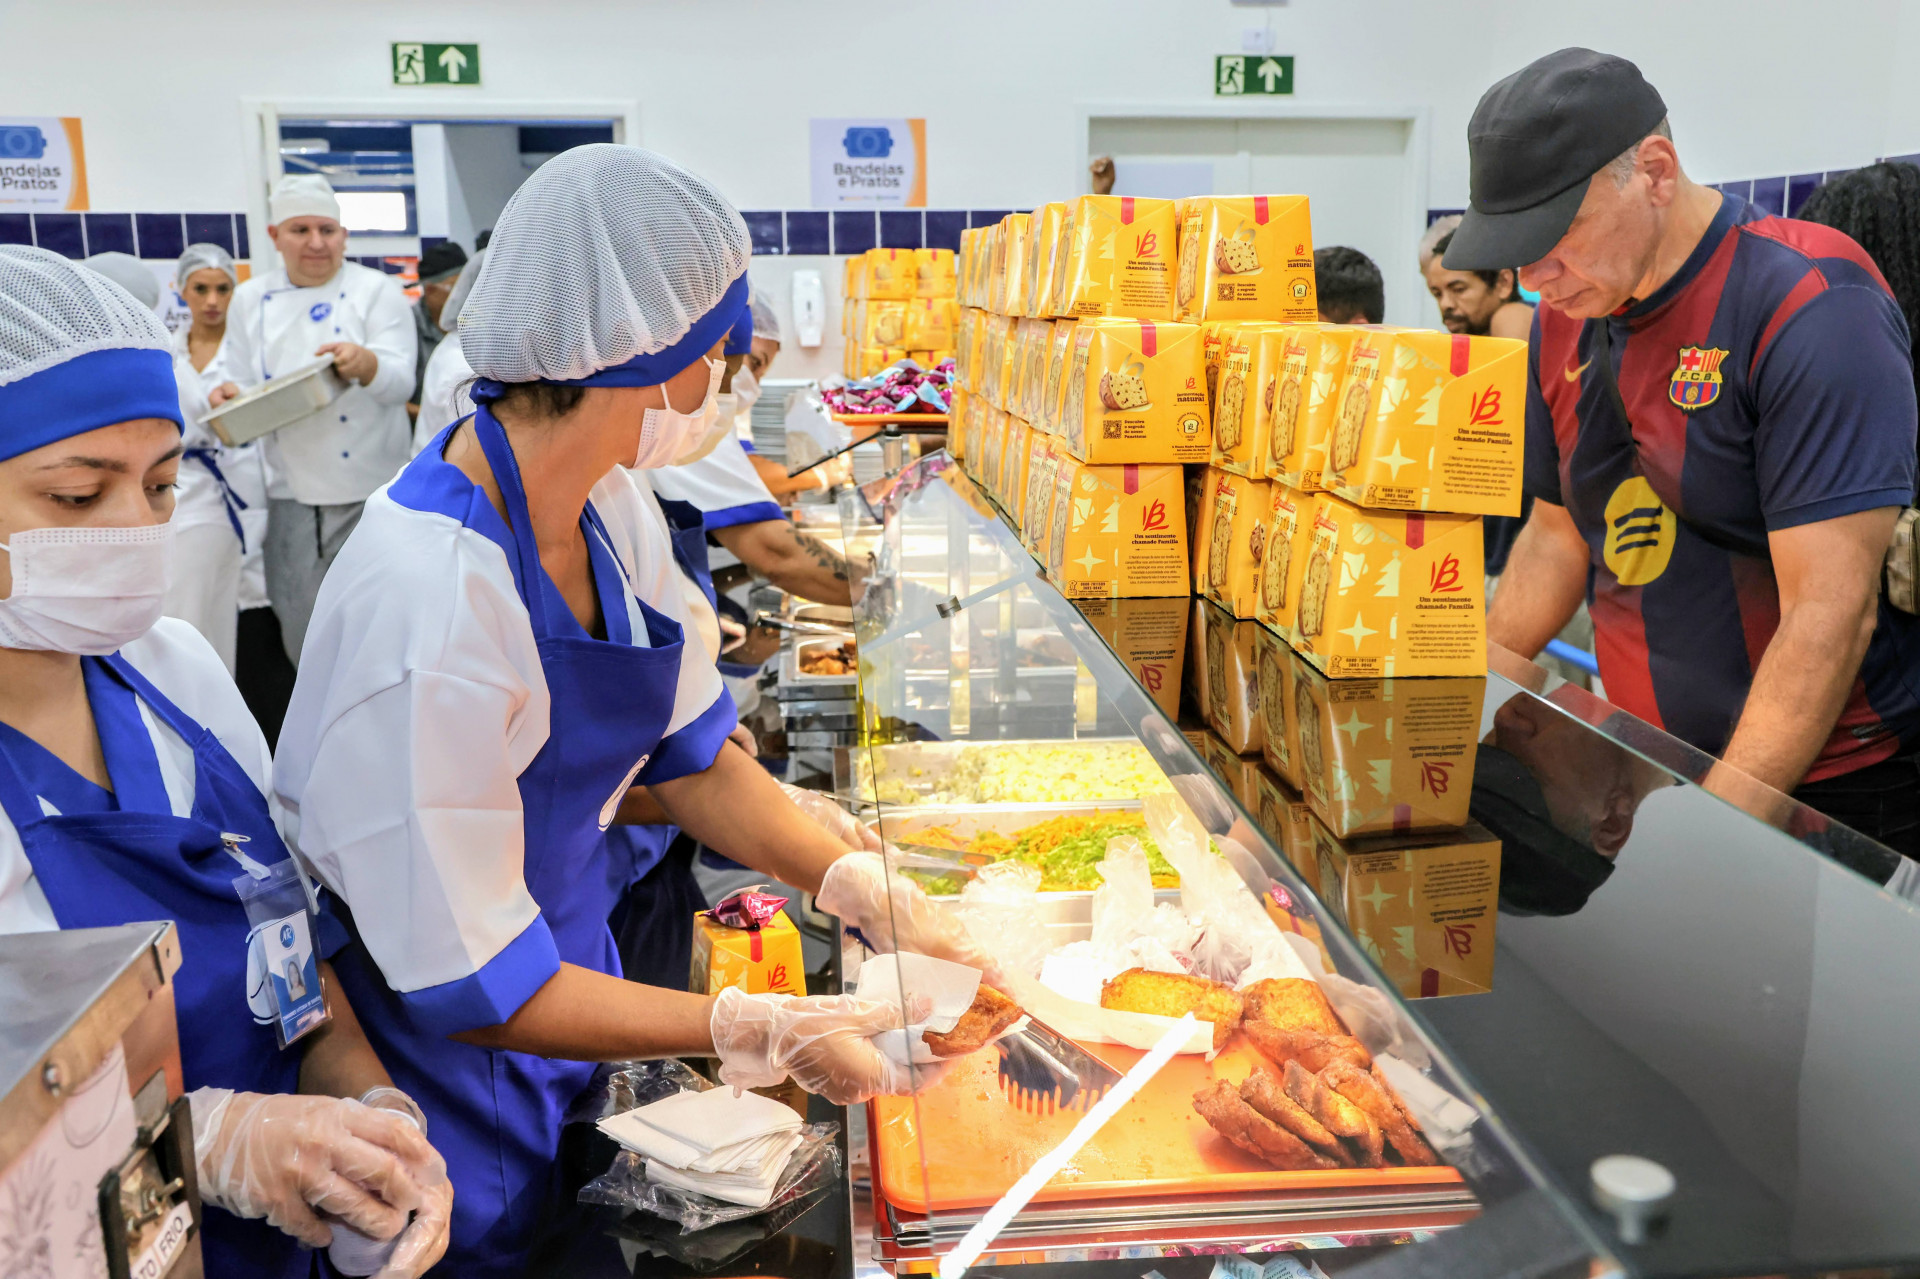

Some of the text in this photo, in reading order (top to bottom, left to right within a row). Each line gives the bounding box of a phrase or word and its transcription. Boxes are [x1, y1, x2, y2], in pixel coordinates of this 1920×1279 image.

[0, 164, 61, 178] ndejas
[833, 163, 904, 179] Bandejas
[2, 177, 57, 190] Pratos
[838, 176, 900, 188] e Pratos
[165, 305, 190, 321] Áre
[1680, 372, 1715, 381] F.C.B.
[1471, 429, 1511, 437] sentimento
[159, 1216, 184, 1258] FRIO
[134, 1259, 157, 1279] TO
